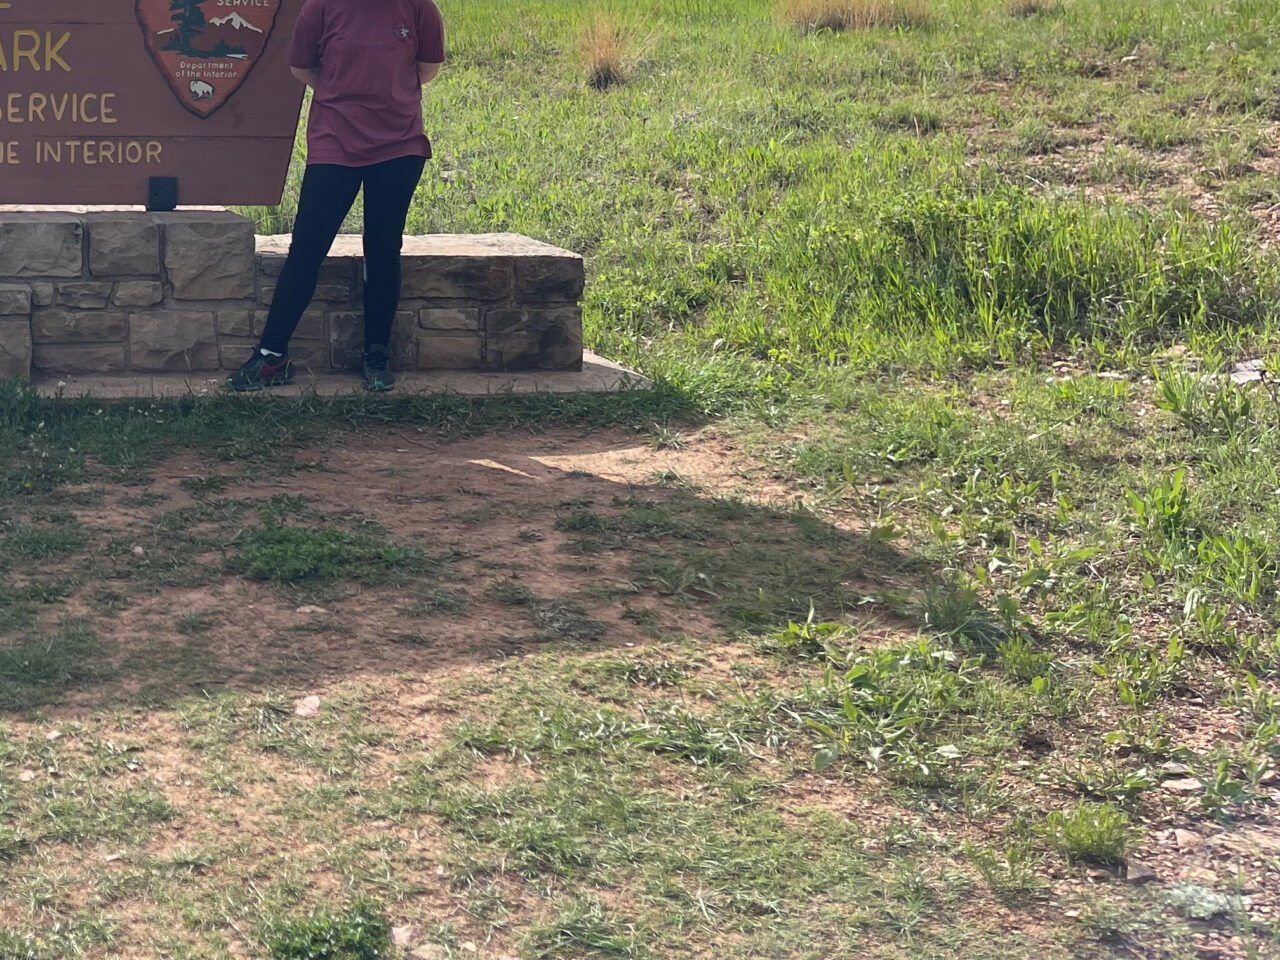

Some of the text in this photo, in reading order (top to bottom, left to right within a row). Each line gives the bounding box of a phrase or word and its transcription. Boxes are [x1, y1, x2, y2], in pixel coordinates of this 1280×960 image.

[180, 61, 233, 71] Department
[175, 70, 238, 79] of the Interior
[35, 141, 163, 165] INTERIOR
